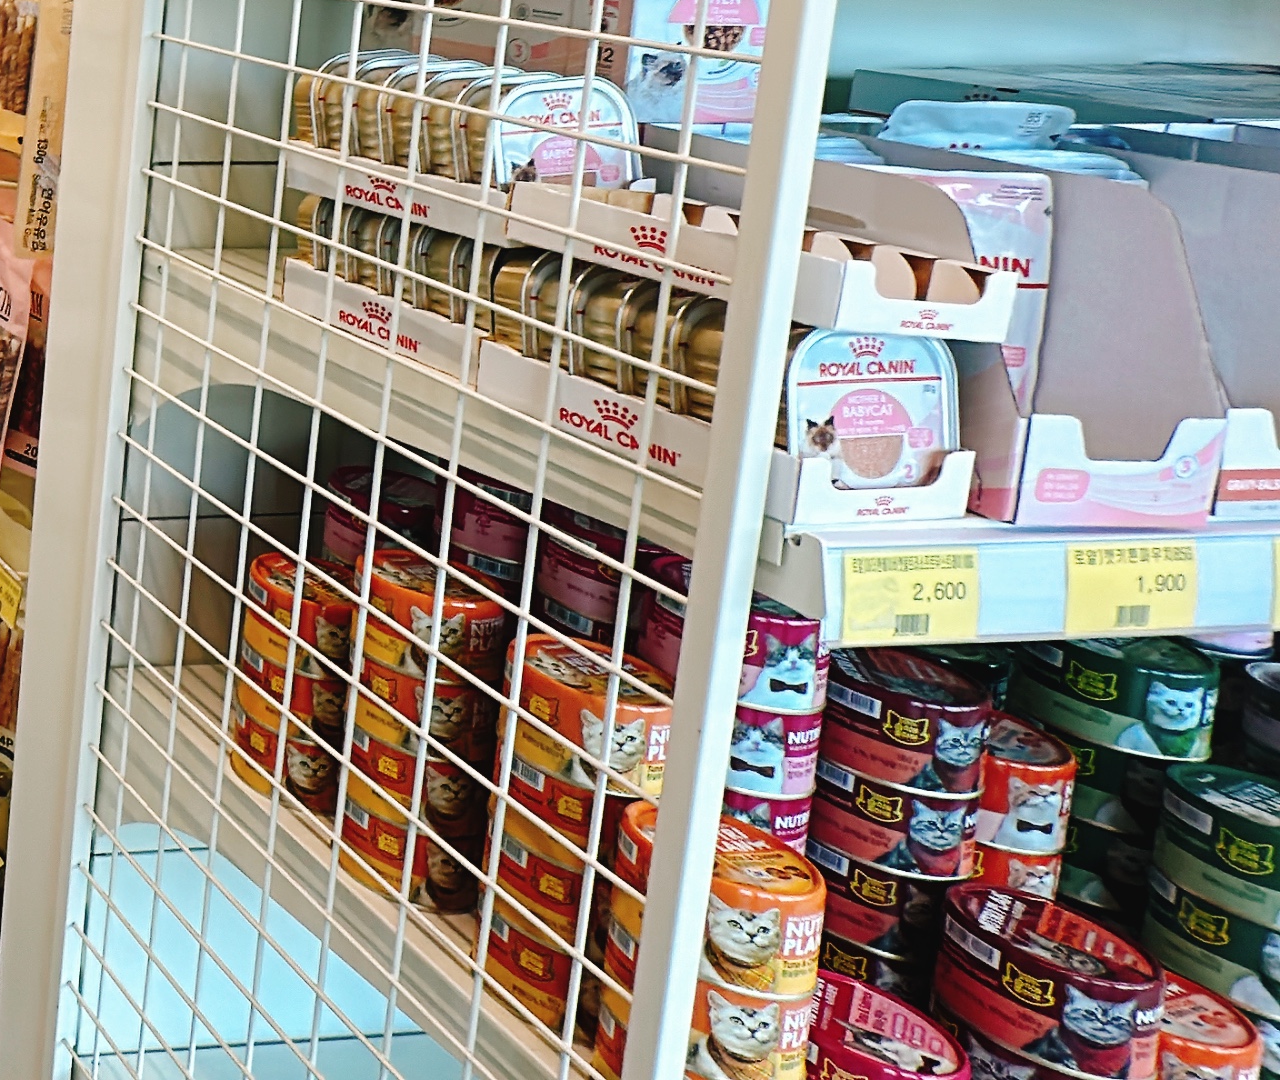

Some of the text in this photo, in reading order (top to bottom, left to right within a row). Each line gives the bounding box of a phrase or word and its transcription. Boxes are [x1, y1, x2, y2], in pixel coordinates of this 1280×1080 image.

[31, 137, 49, 165] 130g
[344, 184, 385, 208] ROYAL
[28, 187, 54, 253] 연어우유껌
[338, 308, 376, 336] ROYAL
[818, 359, 915, 378] ROYAL CANIN
[842, 403, 895, 418] BABYCAT
[559, 406, 615, 441] ROYAL
[903, 463, 914, 479] 2
[911, 580, 967, 603] 2,600
[1136, 573, 1187, 595] 1,900
